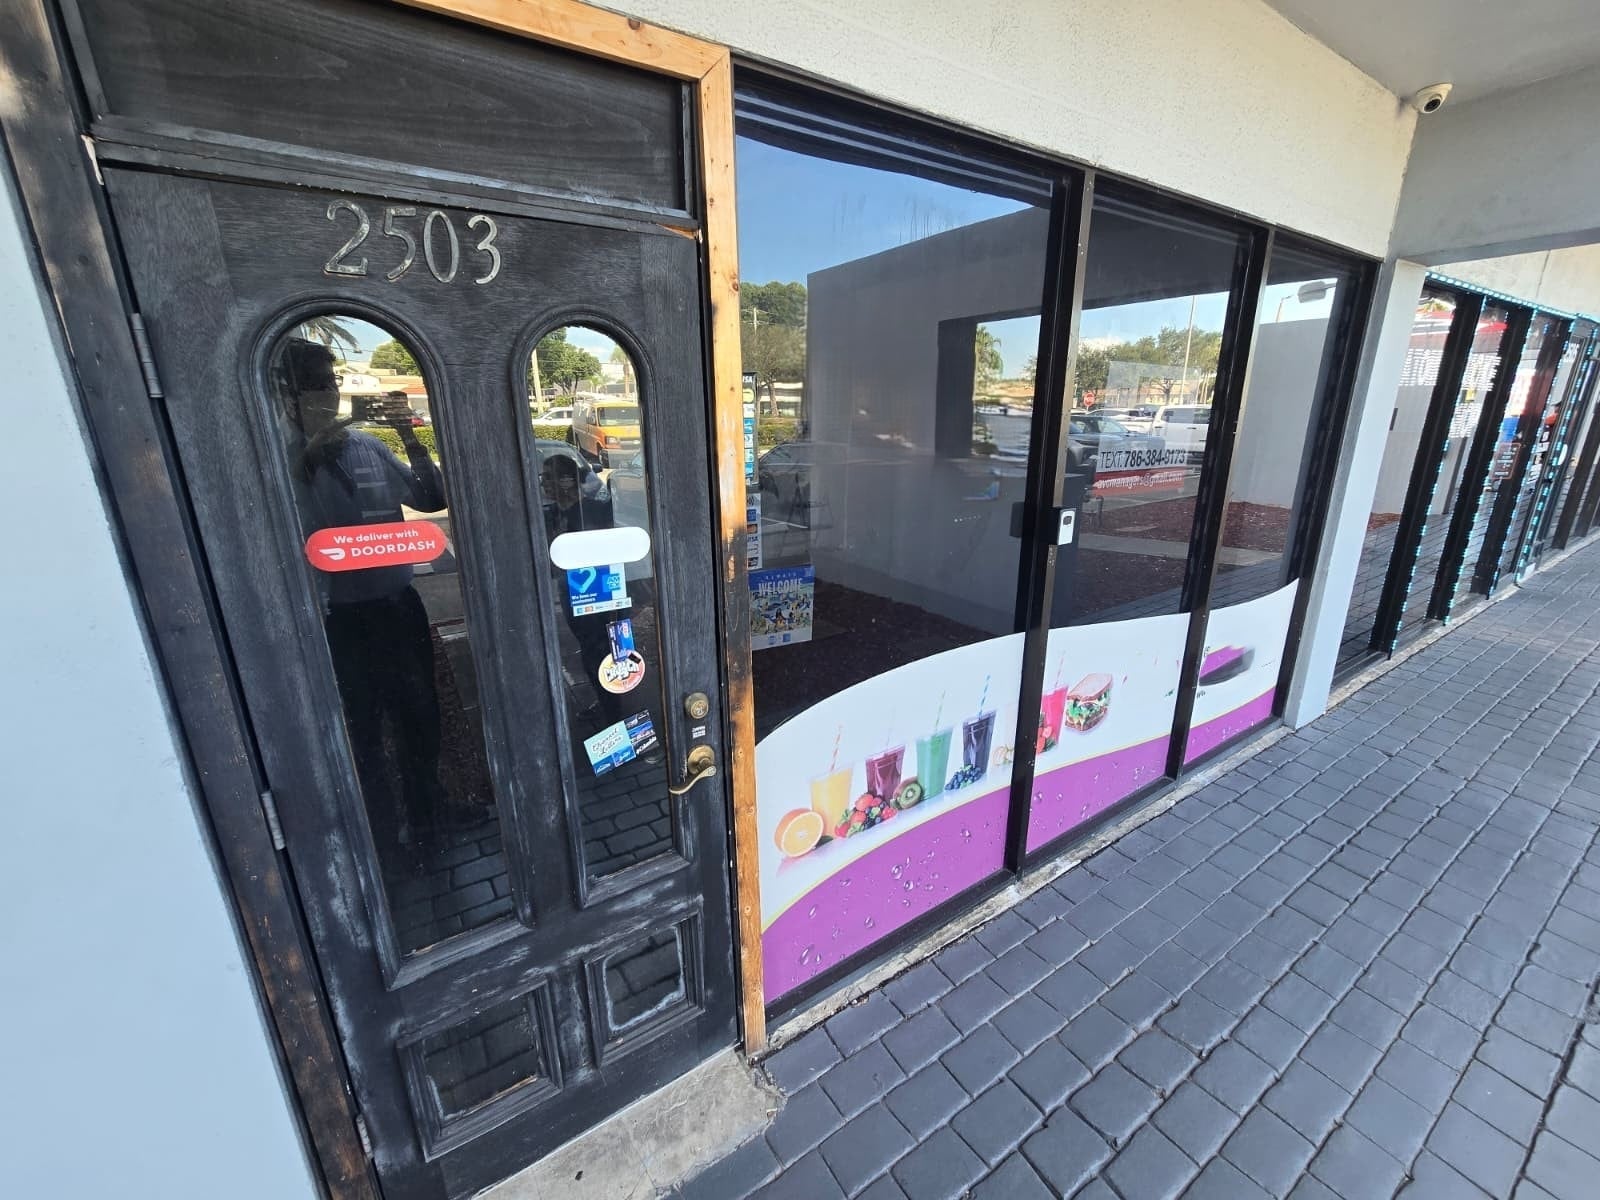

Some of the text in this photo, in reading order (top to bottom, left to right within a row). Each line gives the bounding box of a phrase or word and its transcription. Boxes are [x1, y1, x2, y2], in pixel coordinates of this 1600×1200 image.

[325, 199, 501, 285] 2503
[334, 528, 419, 544] We deliver with
[351, 540, 436, 557] DOORDASH
[758, 577, 804, 597] WELCOME
